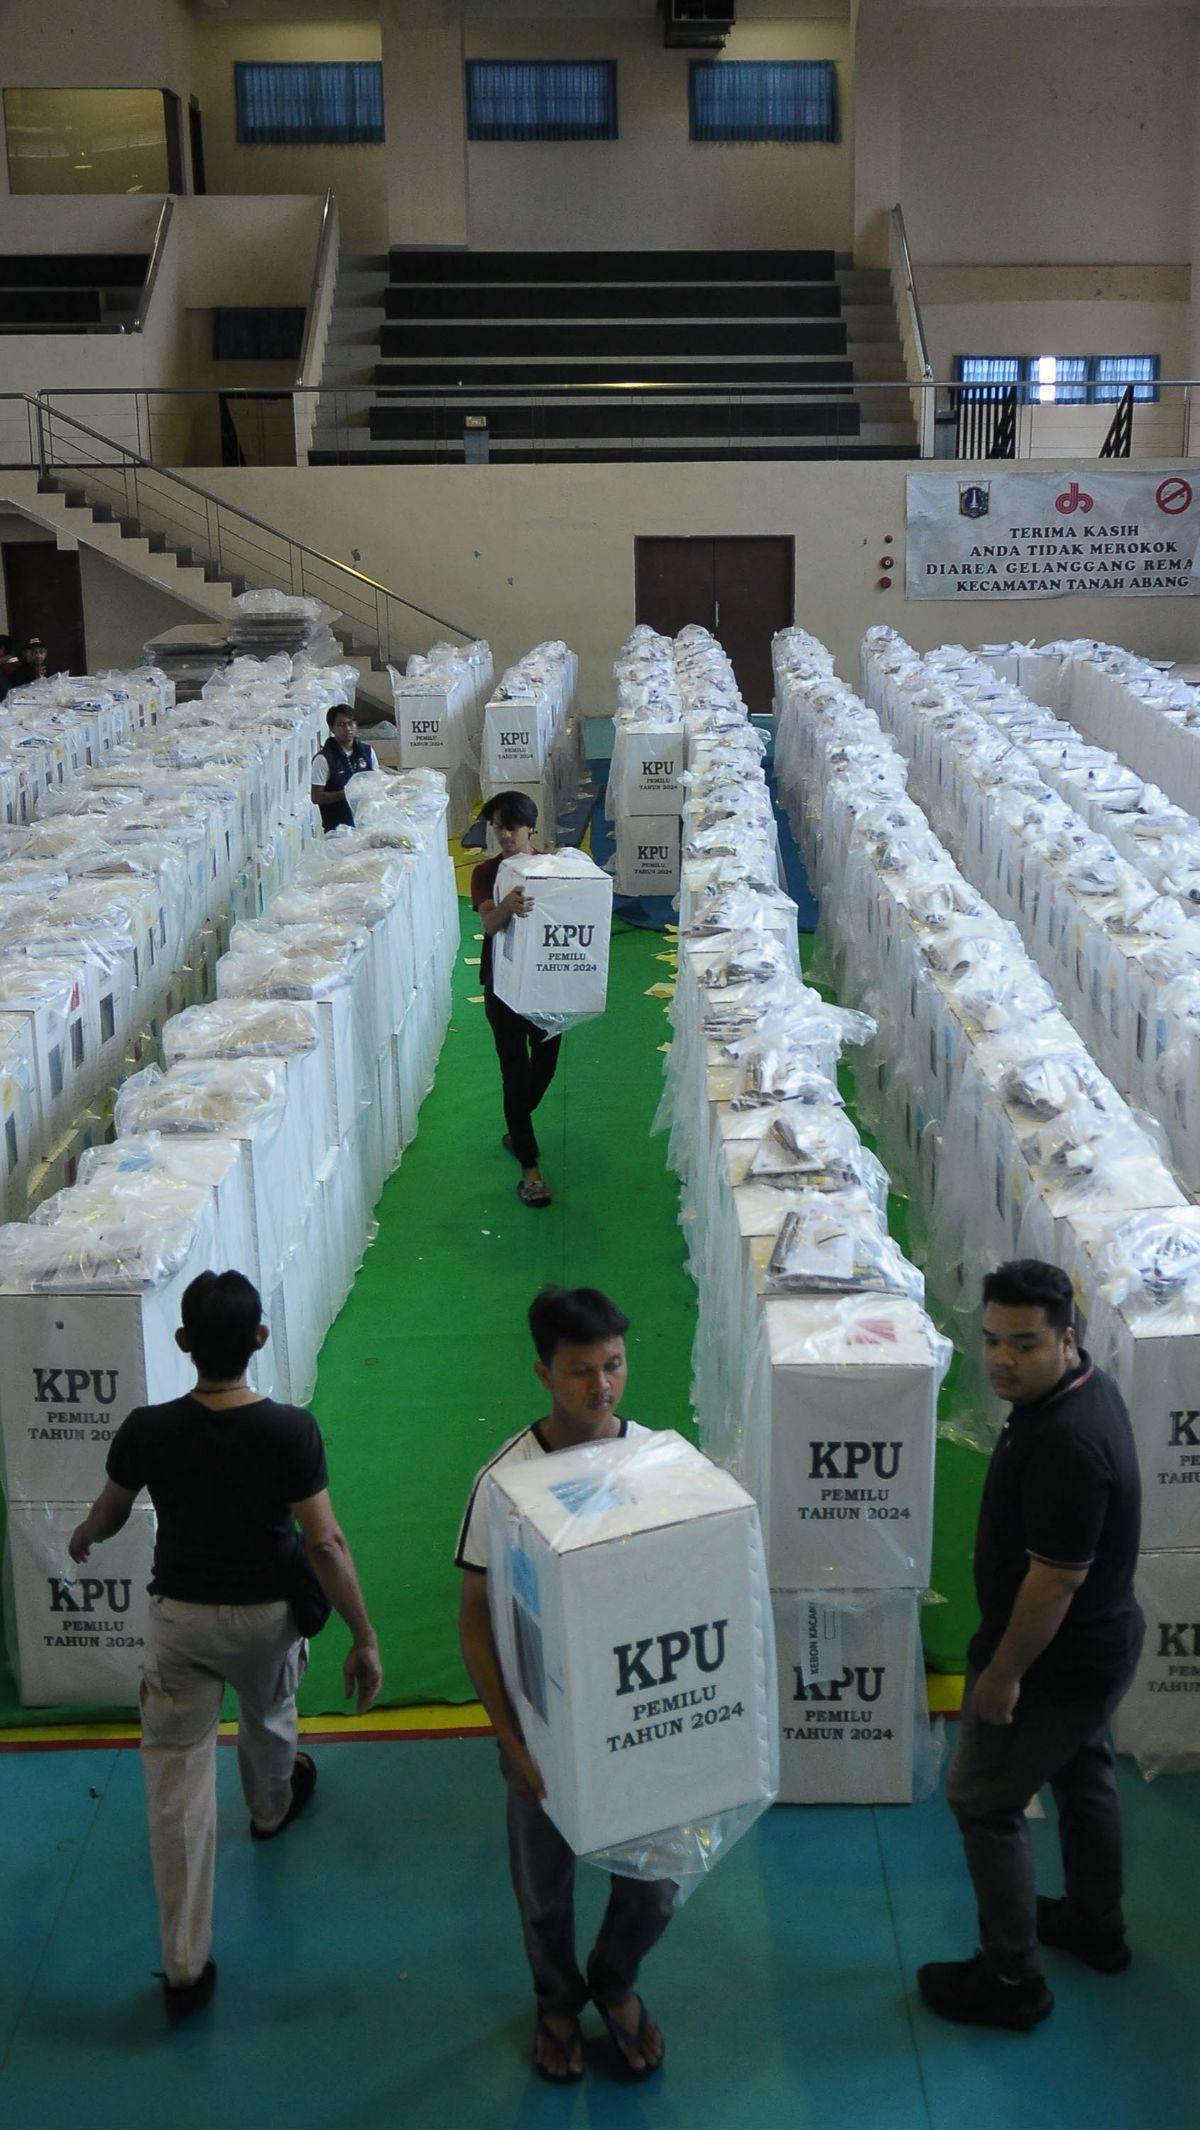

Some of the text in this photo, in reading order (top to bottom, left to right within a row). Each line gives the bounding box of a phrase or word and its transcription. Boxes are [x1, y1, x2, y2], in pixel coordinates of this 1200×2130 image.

[1009, 525, 1139, 539] TERIMA KASIH
[969, 541, 1178, 557] ANDA TIDAK MEROKOK
[926, 558, 1193, 575] DIAREA GELANGGANG REMA
[956, 575, 1189, 592] KECAMATAN TANAH ABANG
[412, 720, 440, 733] KPU
[500, 732, 529, 745] KPU
[642, 761, 674, 775] KPU
[637, 845, 669, 860] KPU
[542, 924, 595, 947] KPU
[549, 952, 586, 960] PEMILU
[536, 963, 597, 971] TAHUN 2024
[33, 1368, 119, 1404] KPU
[47, 1411, 110, 1424] PEMILU
[28, 1427, 85, 1441] TAHUN
[808, 1441, 903, 1479] KPU
[821, 1489, 890, 1501] PEMILU
[798, 1507, 911, 1520] TAHUN 2024
[47, 1577, 132, 1613] KPU
[62, 1620, 125, 1632] PEMILU
[807, 1601, 818, 1639] KACAN
[44, 1635, 145, 1647] TAHUN 2024
[613, 1618, 729, 1696] KPU
[632, 1684, 718, 1722] PEMILU
[805, 1710, 873, 1722] PEMILU
[606, 1701, 745, 1752] TAHUN 2024
[784, 1727, 894, 1741] TAHUN 2024
